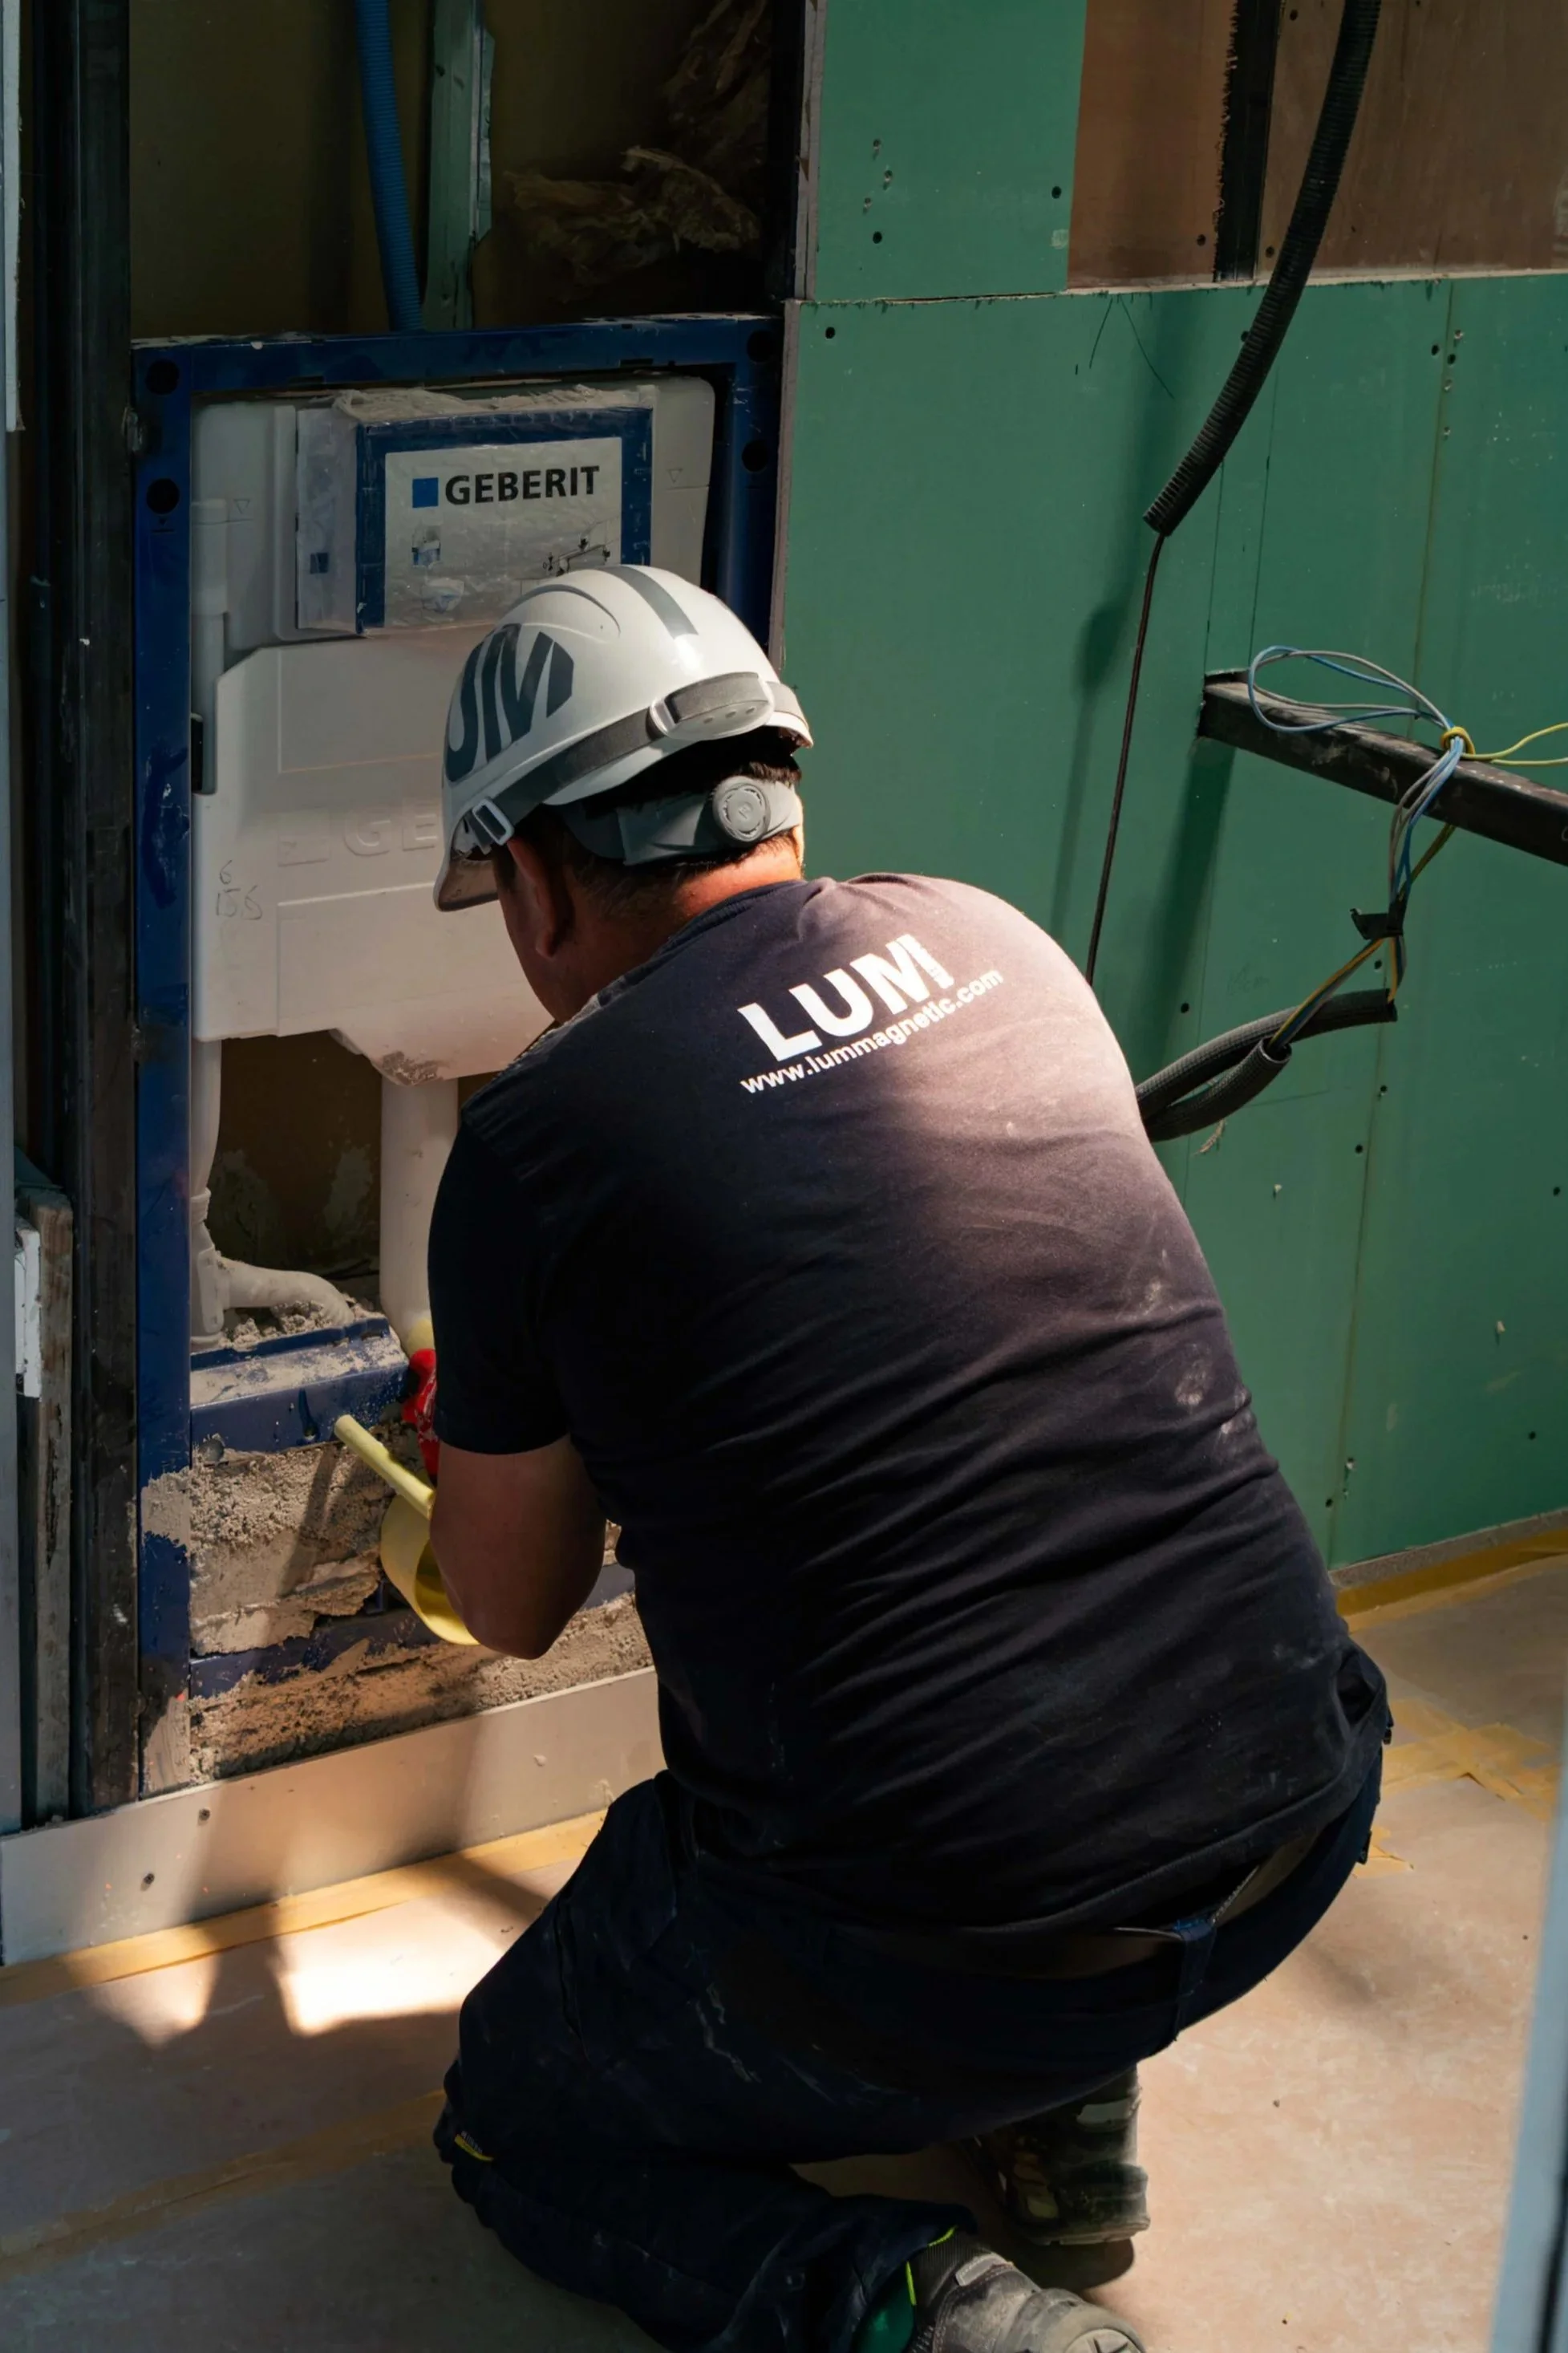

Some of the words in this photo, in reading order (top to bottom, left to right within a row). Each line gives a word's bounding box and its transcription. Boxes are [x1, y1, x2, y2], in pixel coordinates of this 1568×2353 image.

[445, 465, 600, 505] GEBERIT
[736, 933, 954, 1062] LUM
[739, 969, 1004, 1095] www.lummagnetic.com
